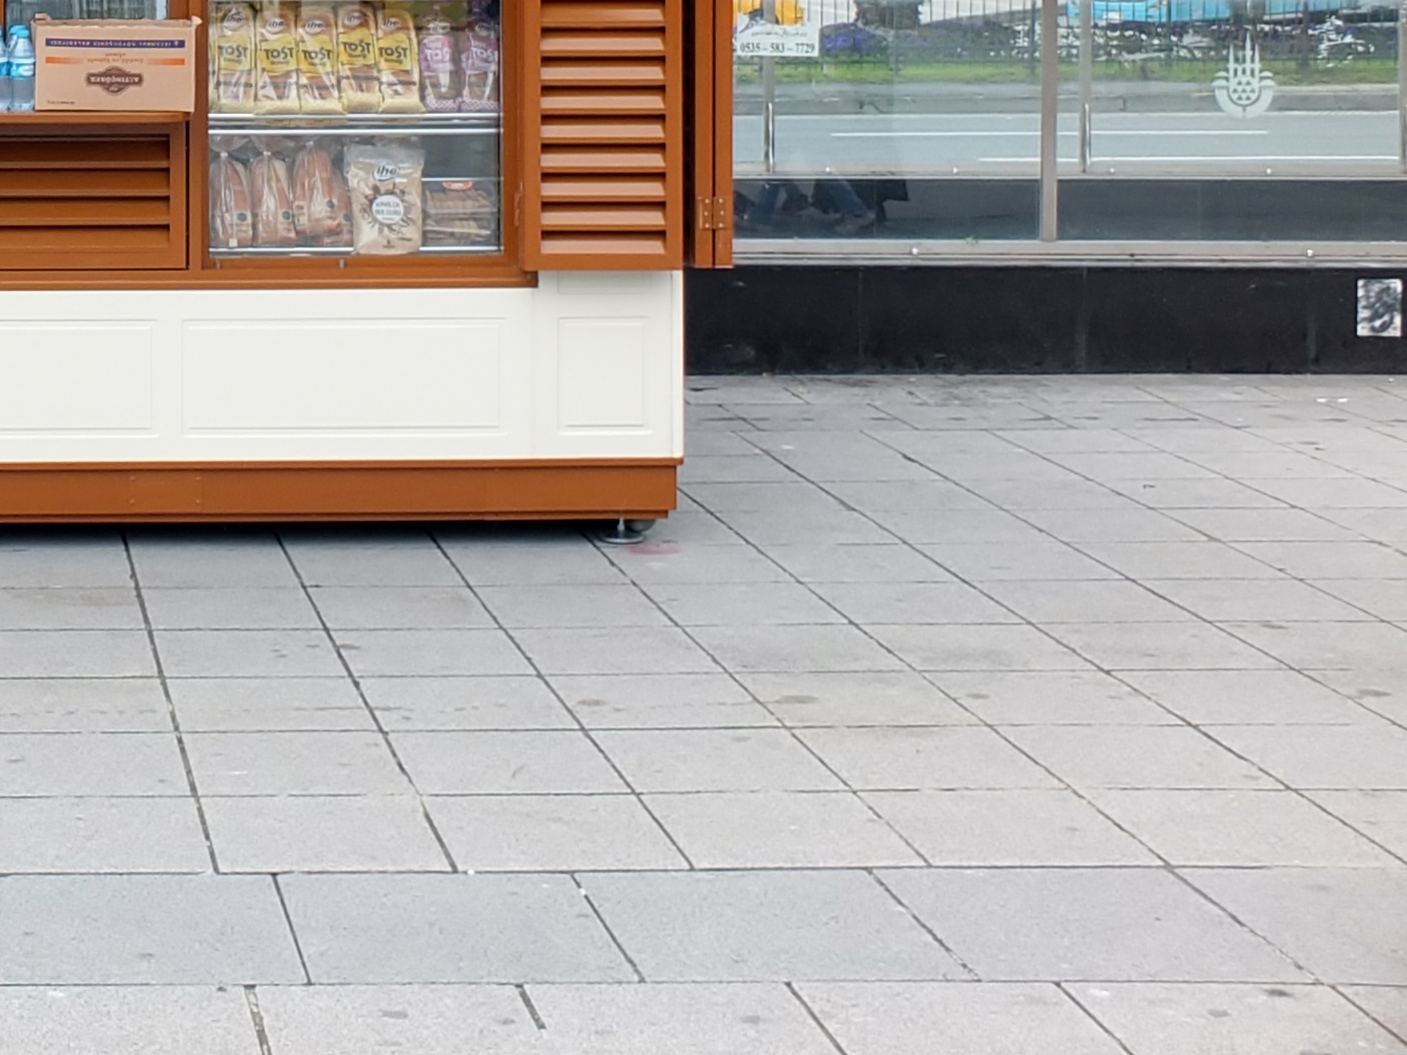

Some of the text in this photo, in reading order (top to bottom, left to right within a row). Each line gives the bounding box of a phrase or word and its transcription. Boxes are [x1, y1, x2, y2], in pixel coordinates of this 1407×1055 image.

[218, 44, 249, 58] TOST
[263, 46, 295, 60] TOST
[341, 39, 371, 54] TOST
[378, 45, 408, 58] TOST
[301, 47, 332, 61] TOST
